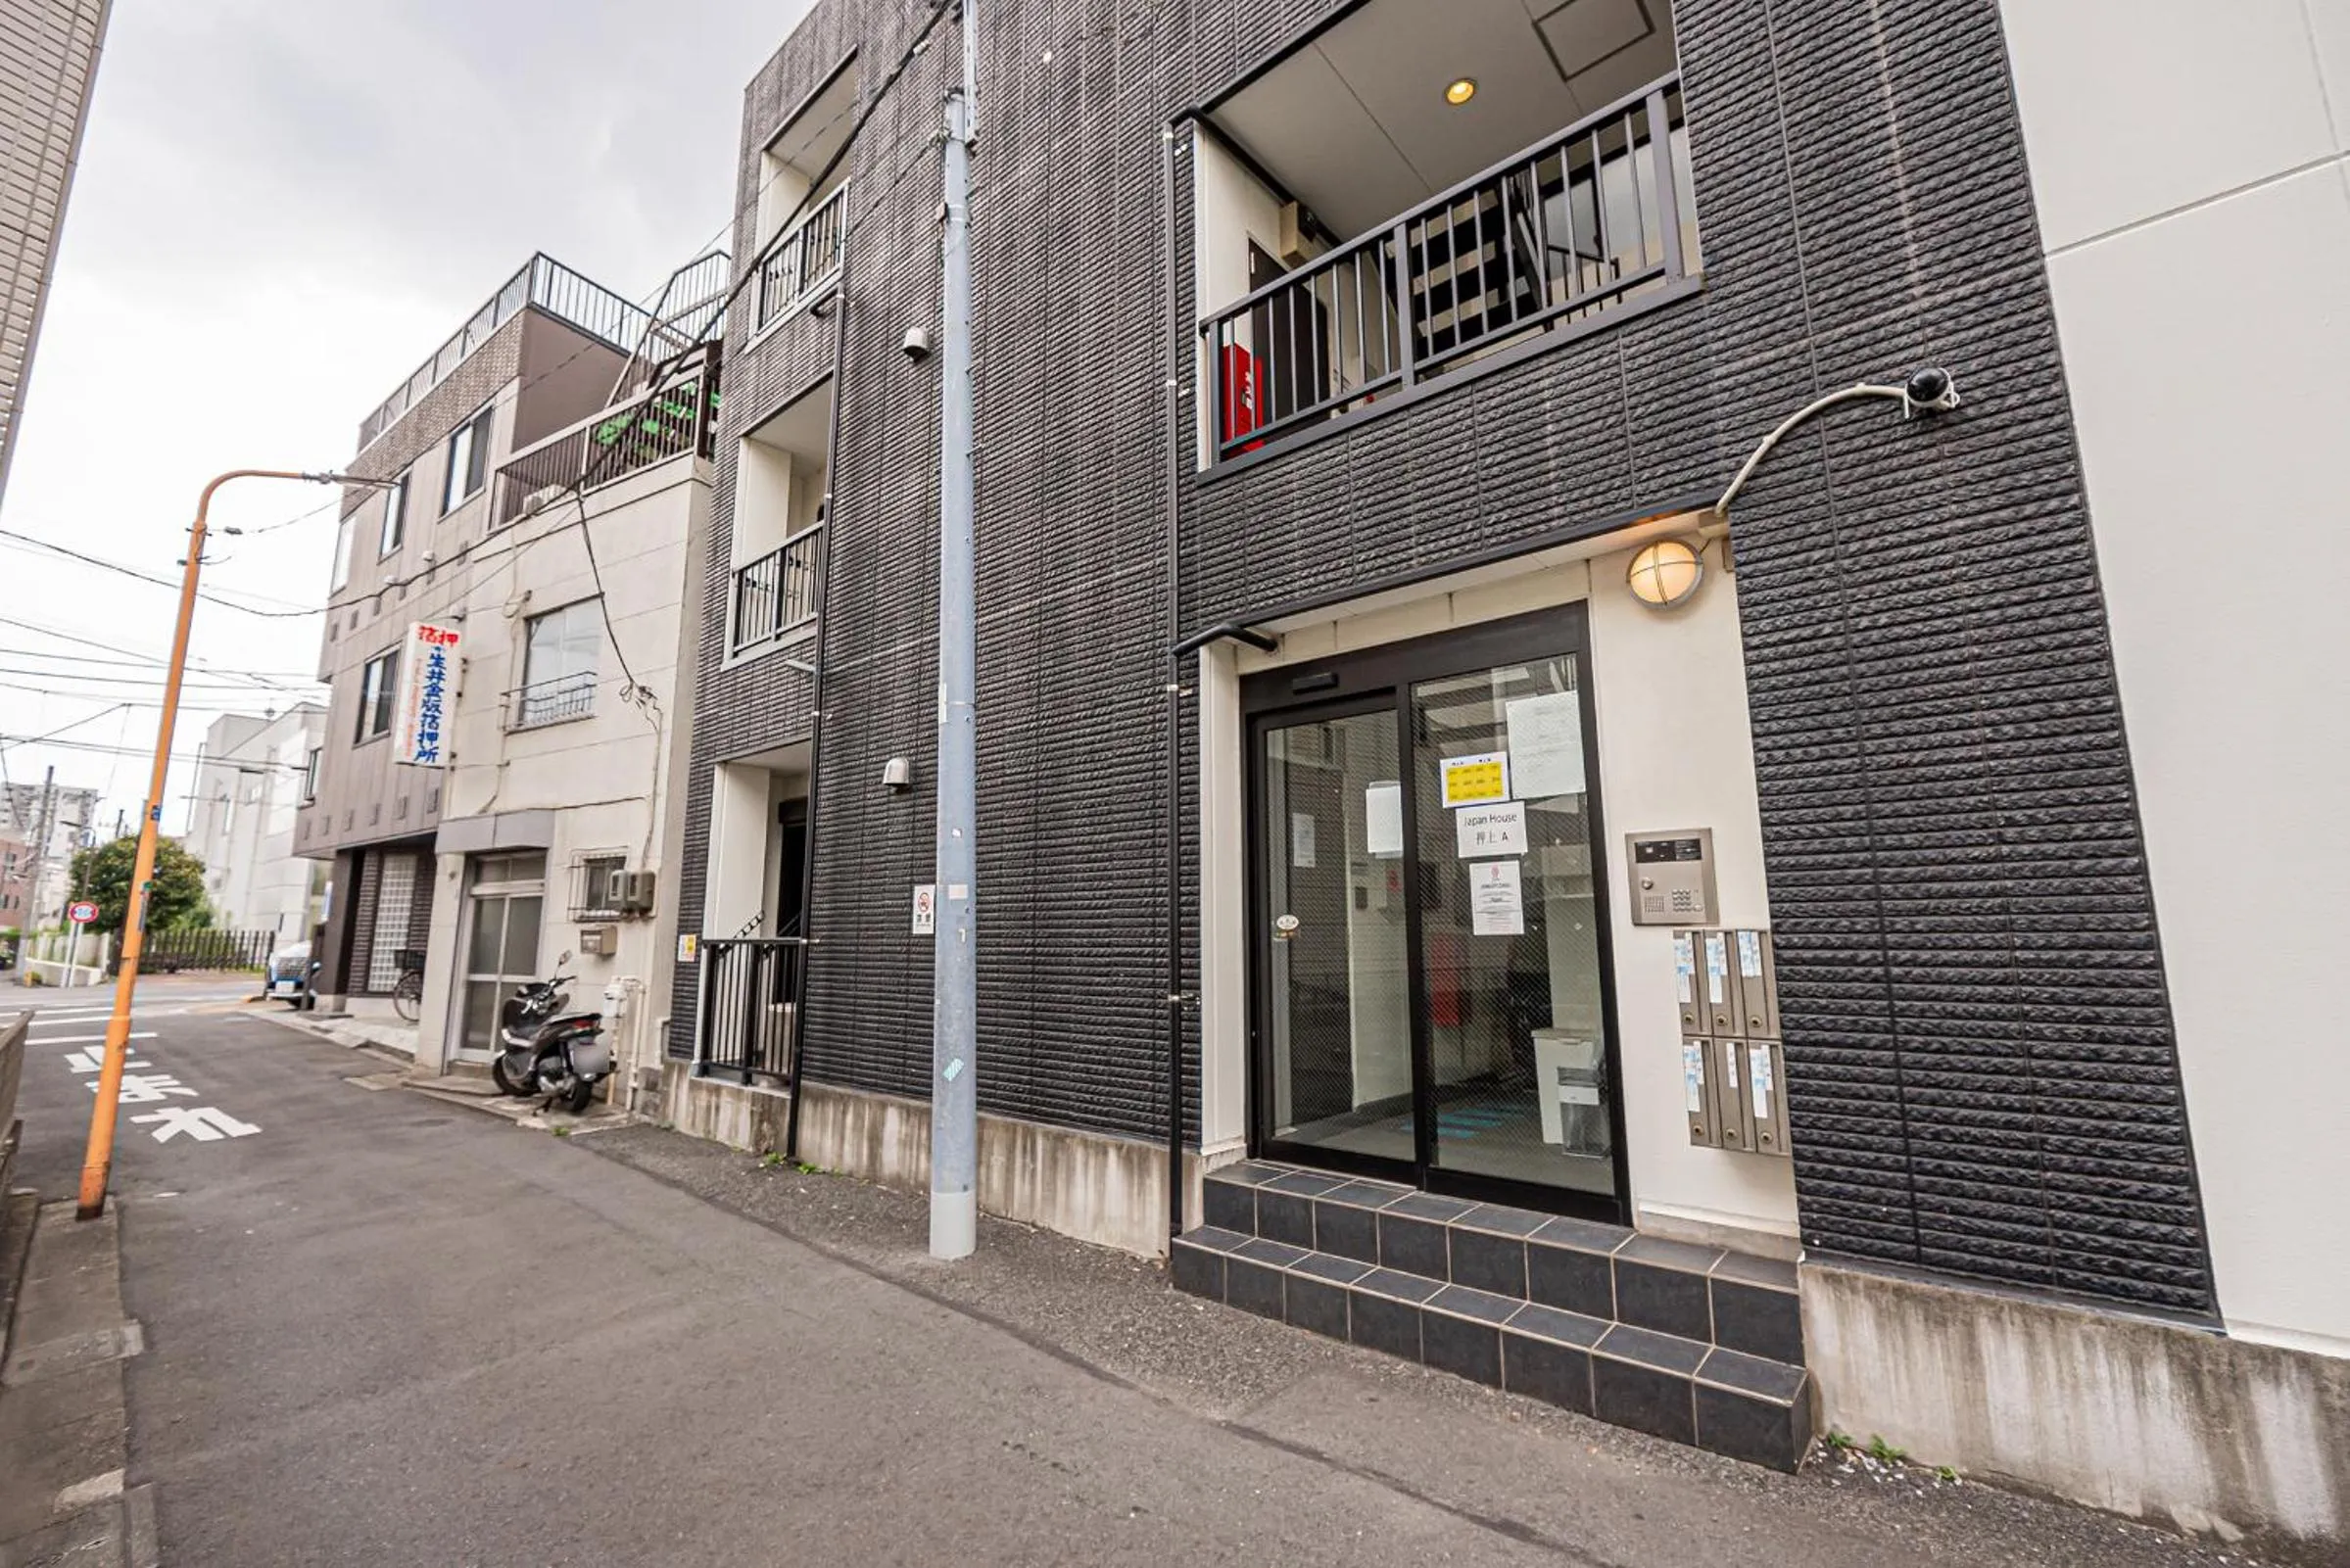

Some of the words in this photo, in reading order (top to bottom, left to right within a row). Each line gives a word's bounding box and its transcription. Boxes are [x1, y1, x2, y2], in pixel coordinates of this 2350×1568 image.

[1464, 816, 1488, 827] Japan
[1490, 813, 1517, 824] House
[1502, 831, 1509, 841] A
